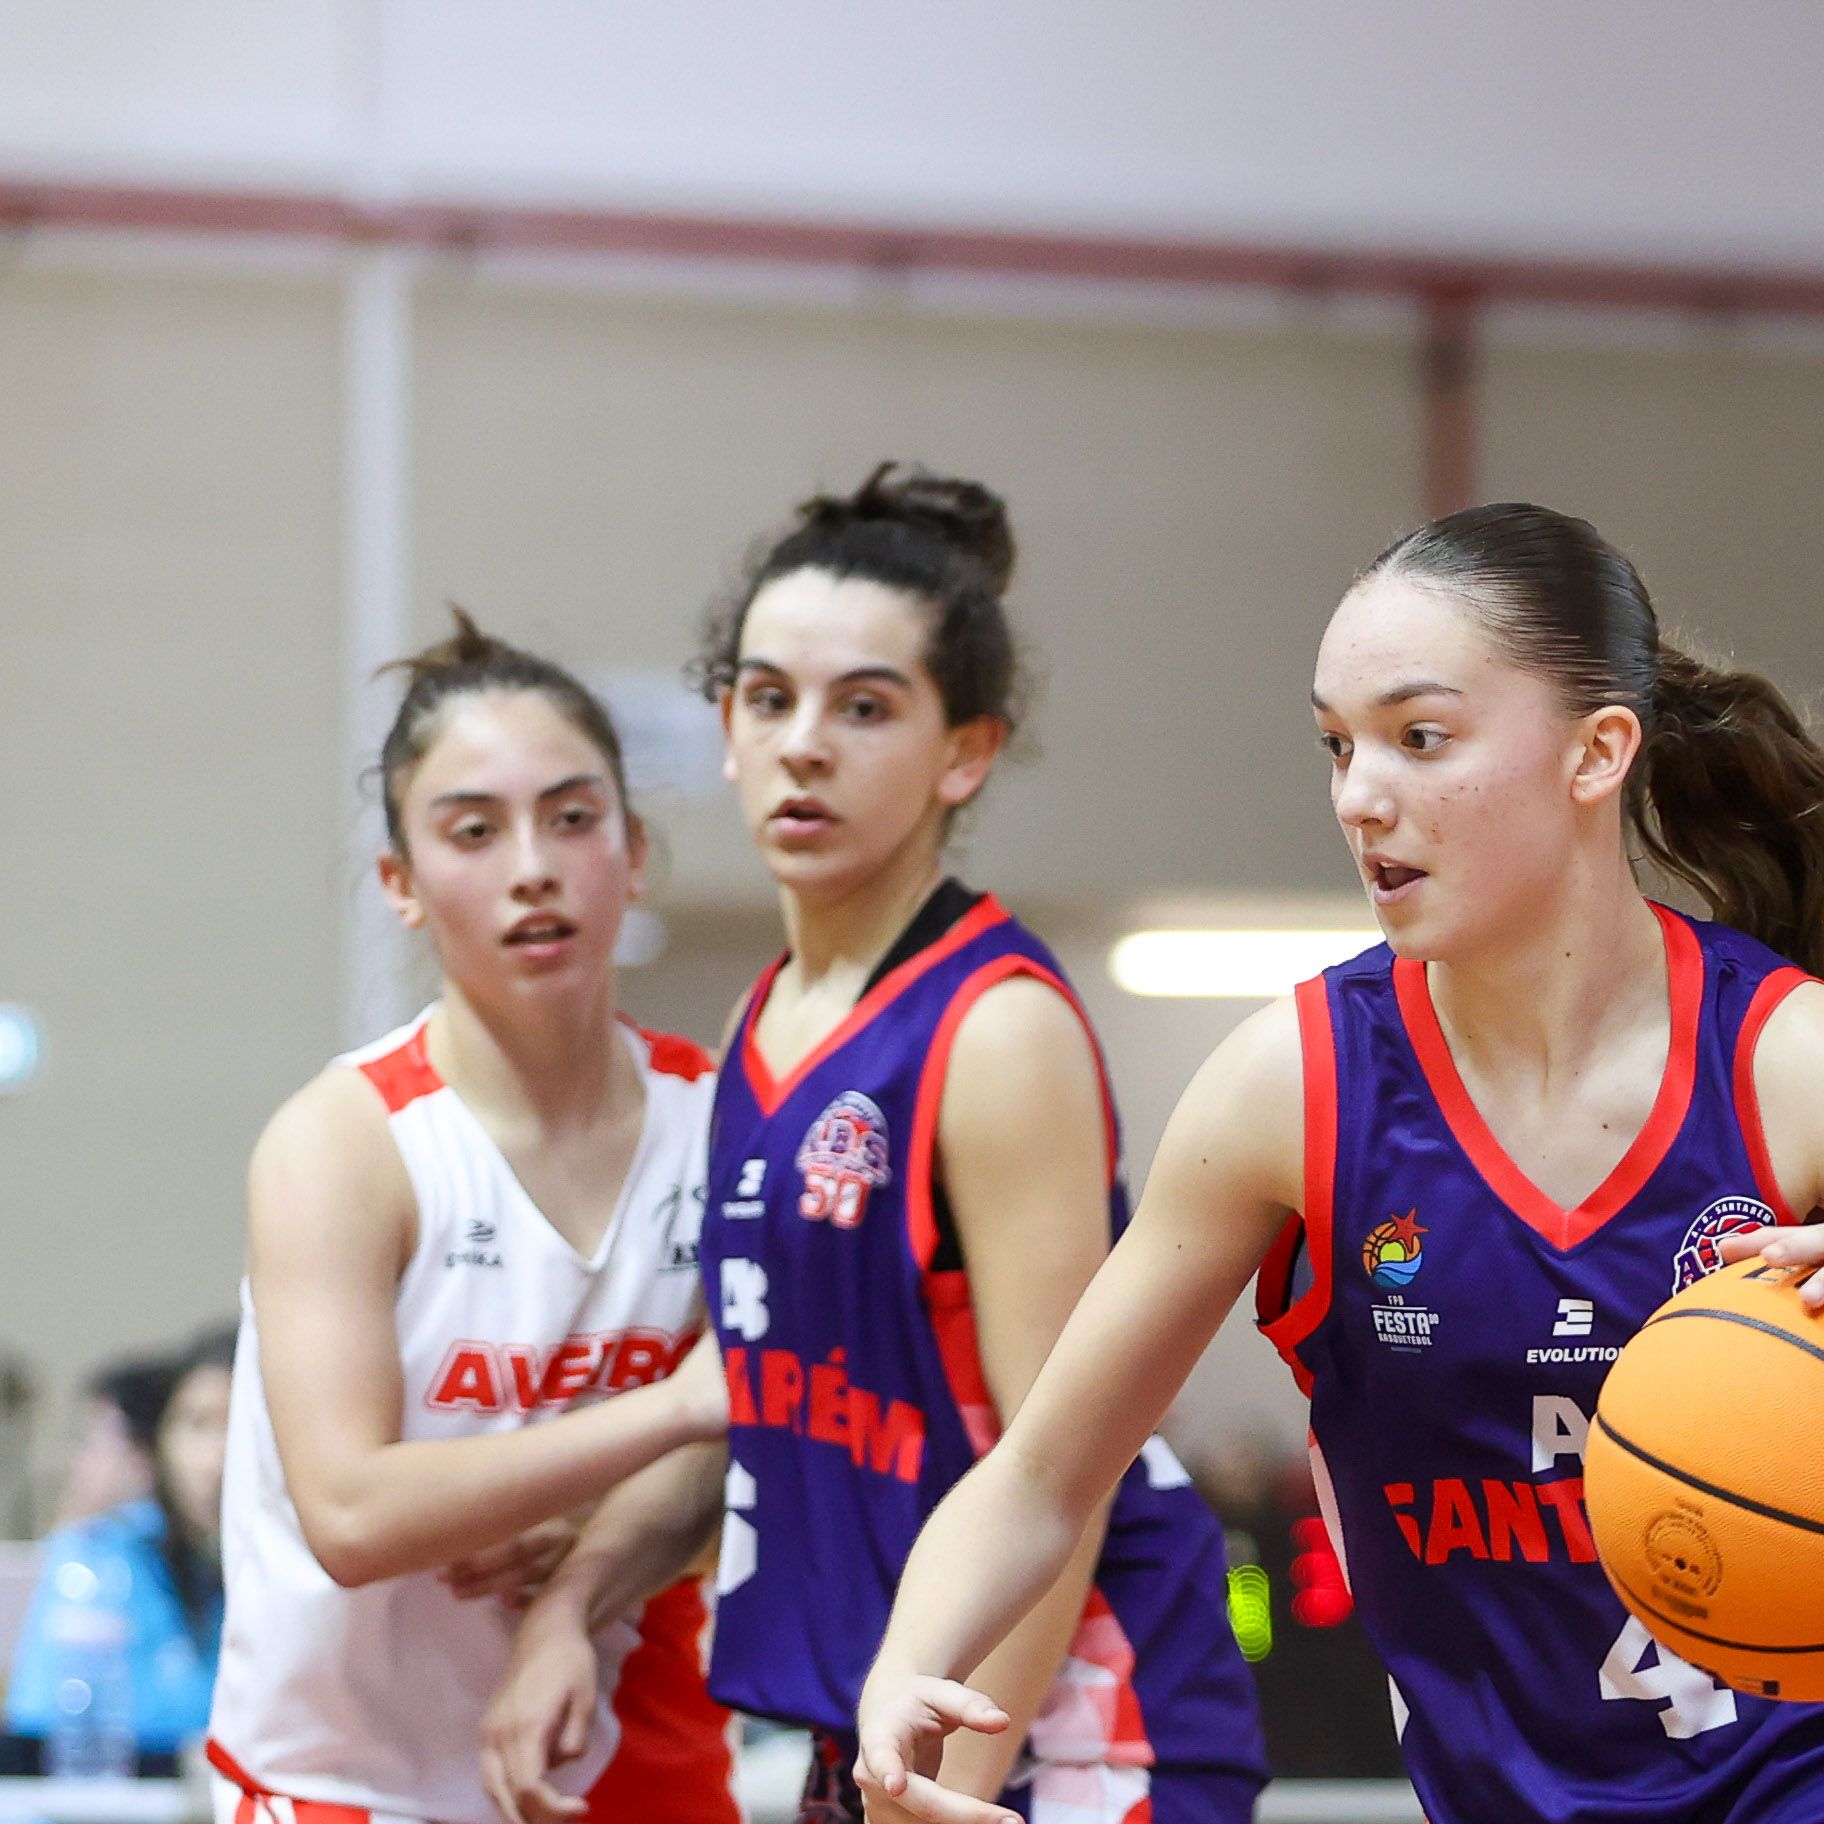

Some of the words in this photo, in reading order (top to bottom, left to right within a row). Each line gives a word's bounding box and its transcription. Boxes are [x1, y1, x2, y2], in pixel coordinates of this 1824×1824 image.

[1373, 1310, 1431, 1334] FESTA
[1526, 1347, 1624, 1364] EVOLUTIO
[1598, 1612, 1738, 1739] 4
